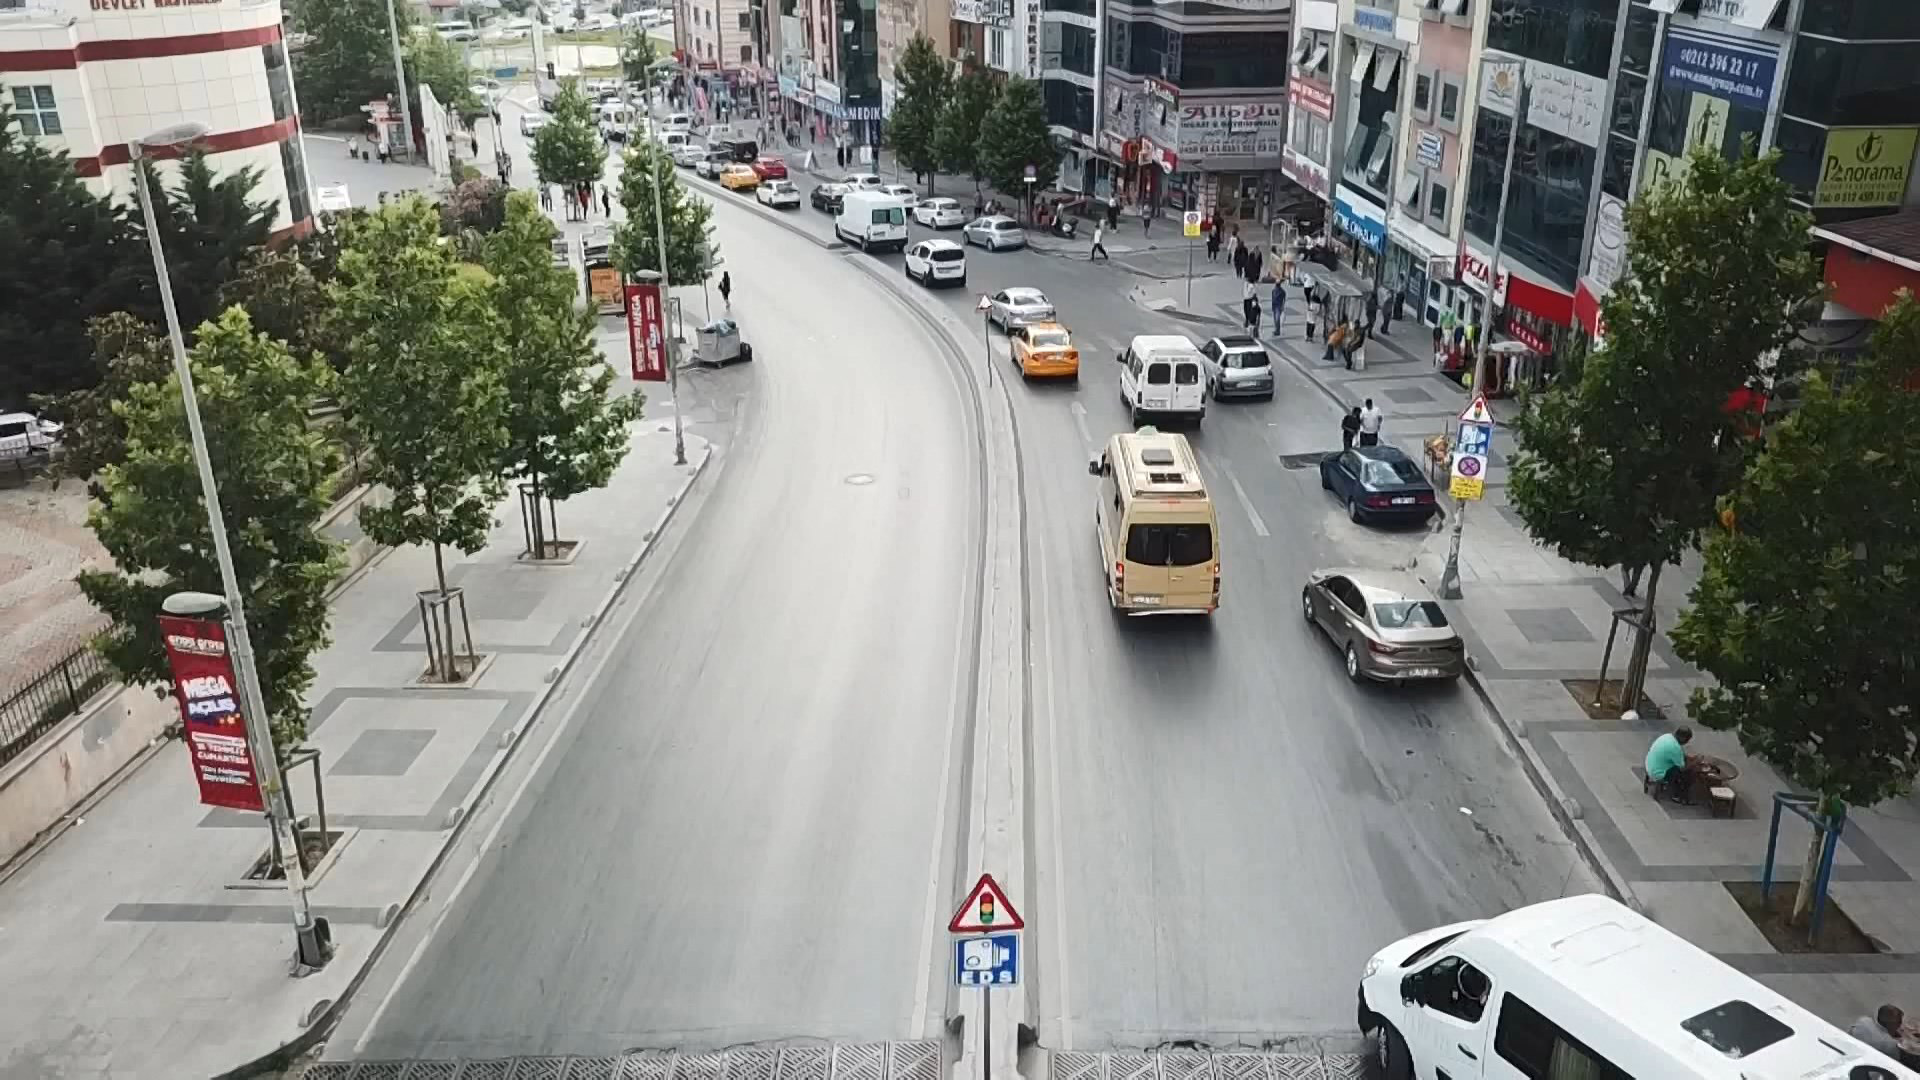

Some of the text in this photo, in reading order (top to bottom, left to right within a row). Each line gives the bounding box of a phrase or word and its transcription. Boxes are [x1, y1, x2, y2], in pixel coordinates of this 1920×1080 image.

[1824, 155, 1904, 182] Panorama
[182, 675, 232, 699] MEGA
[188, 698, 236, 716] AÇILIŞ
